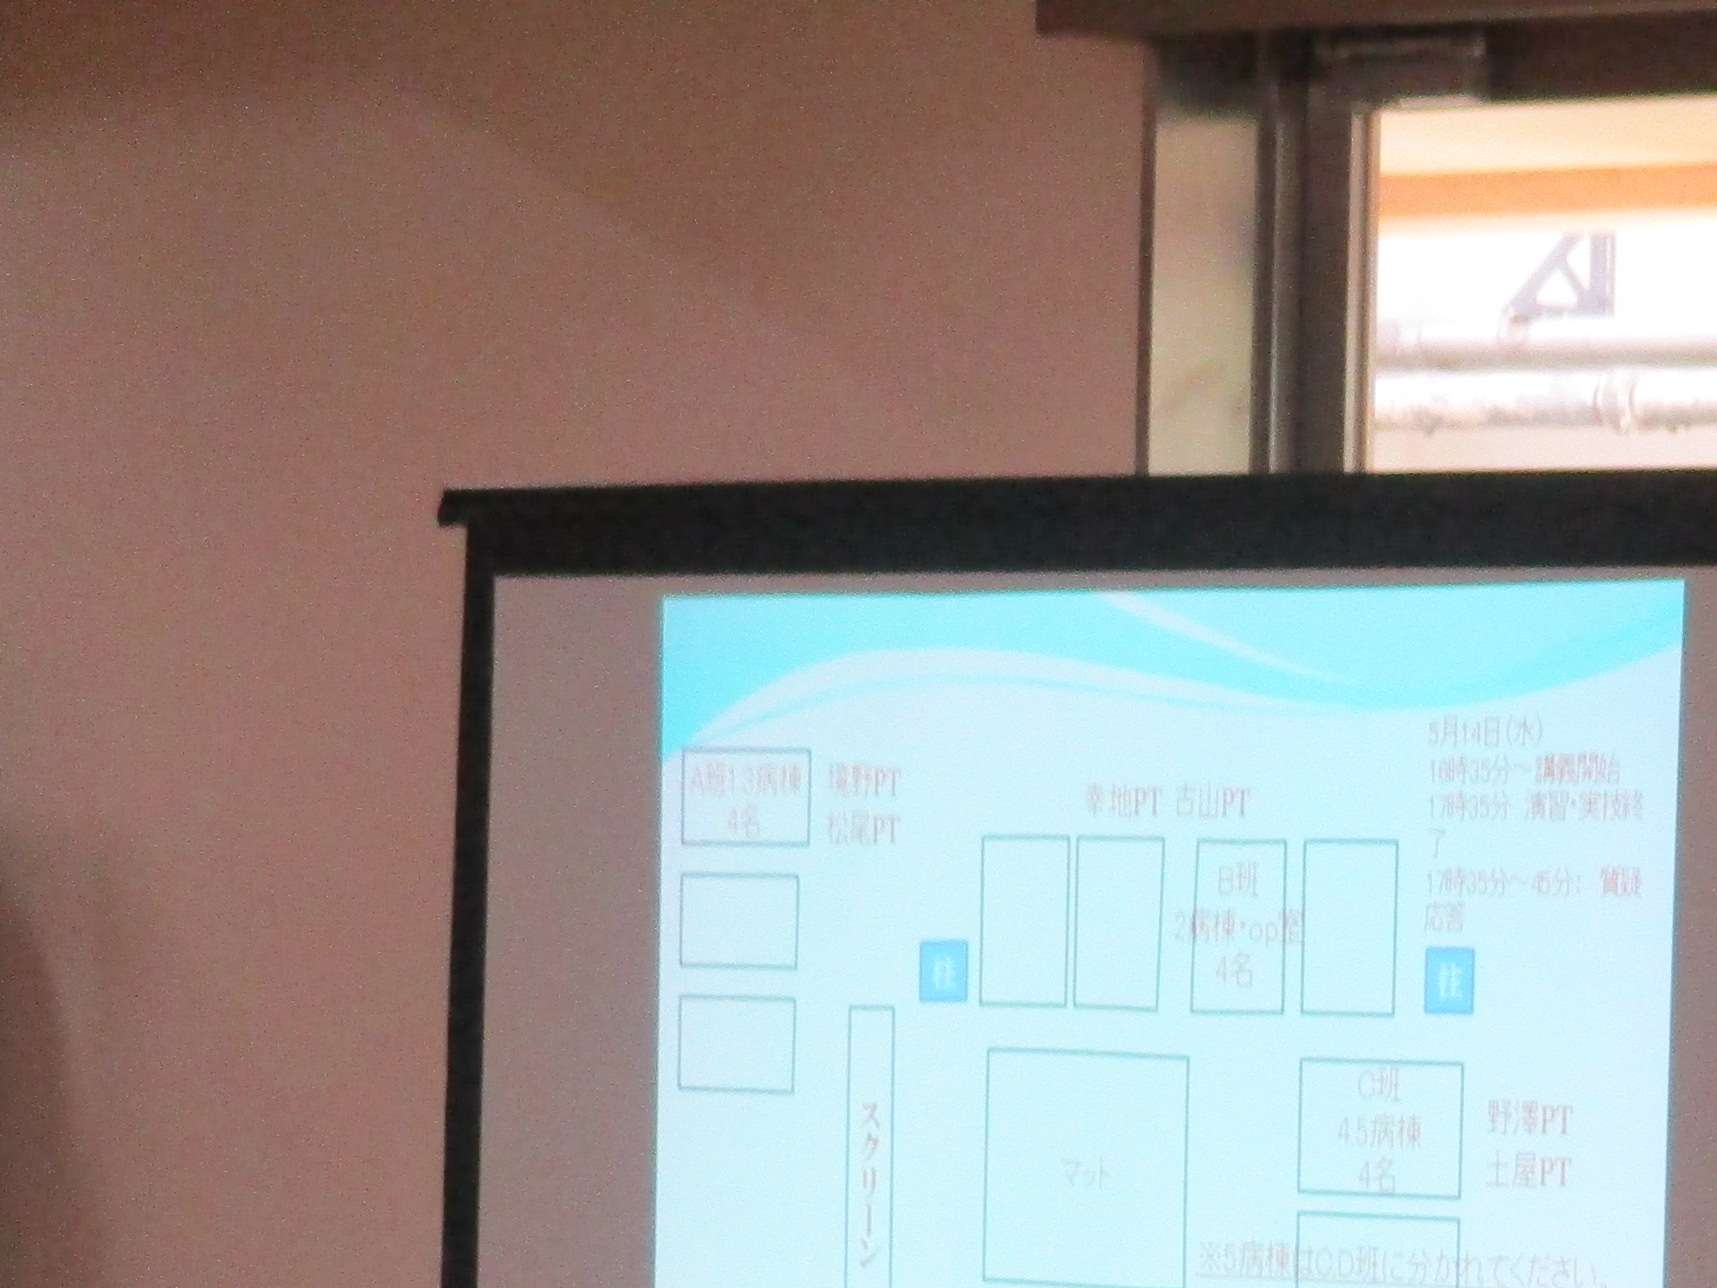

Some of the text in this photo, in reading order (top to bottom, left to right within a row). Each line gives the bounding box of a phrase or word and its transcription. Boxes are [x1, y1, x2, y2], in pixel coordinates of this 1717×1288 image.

[1215, 951, 1254, 989] 4名
[861, 1102, 881, 1269] スクリーン
[1358, 1155, 1396, 1194] 4名
[1485, 1150, 1573, 1189] 土屋PT
